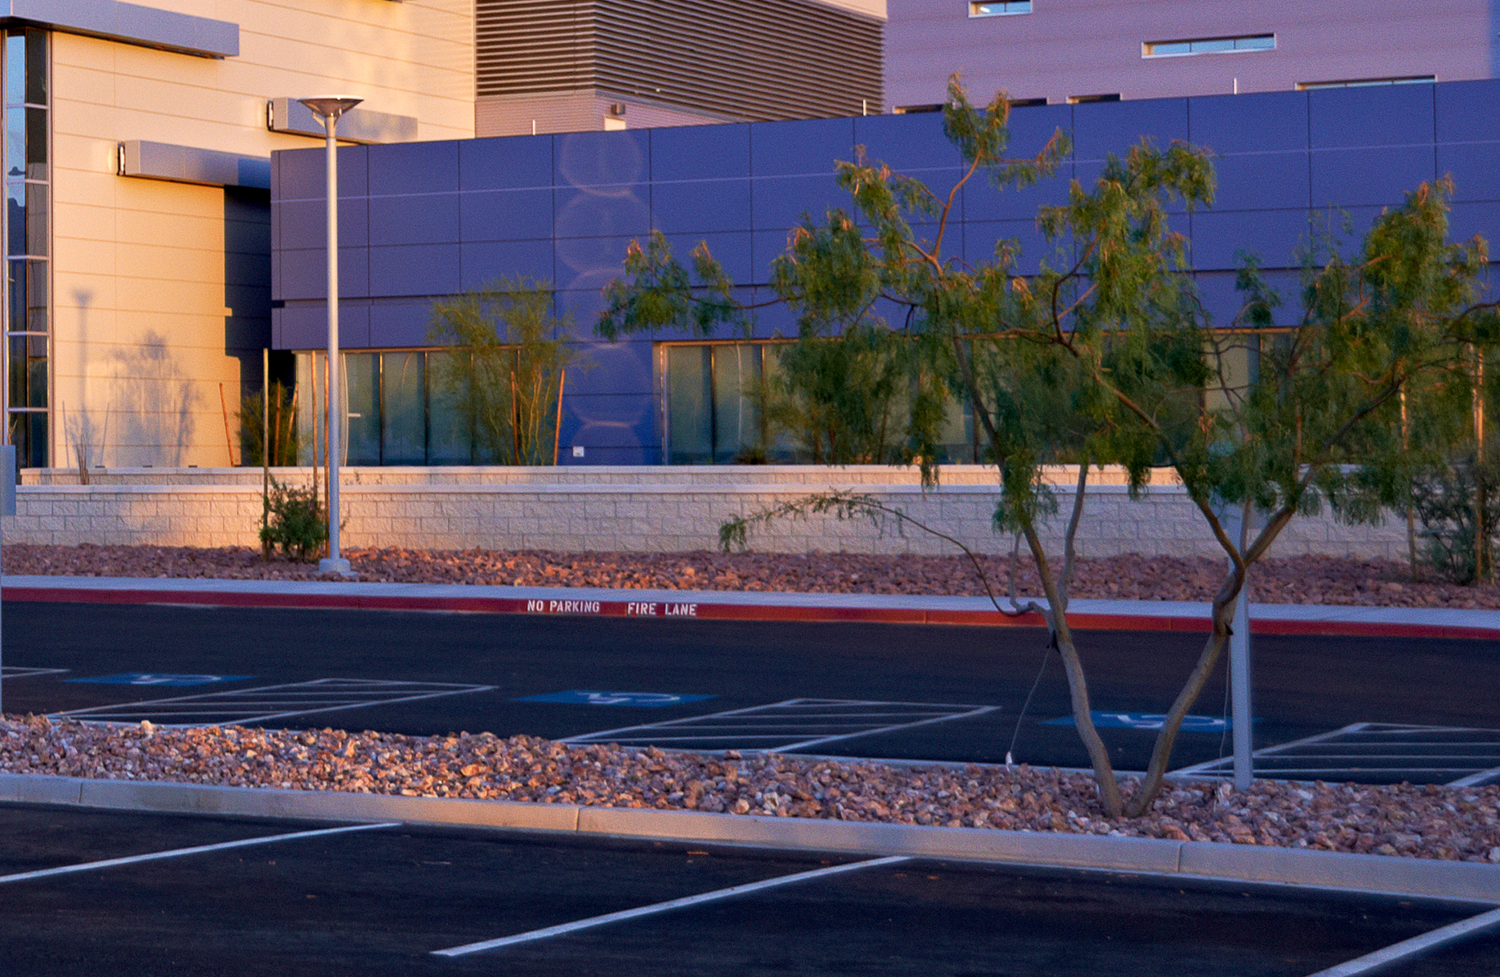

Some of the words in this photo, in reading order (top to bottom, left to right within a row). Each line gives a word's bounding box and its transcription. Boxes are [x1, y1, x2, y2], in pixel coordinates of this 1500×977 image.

[527, 599, 544, 612] NO
[550, 600, 600, 613] PARKING
[627, 602, 657, 615] FIRE
[665, 603, 697, 616] LANE
